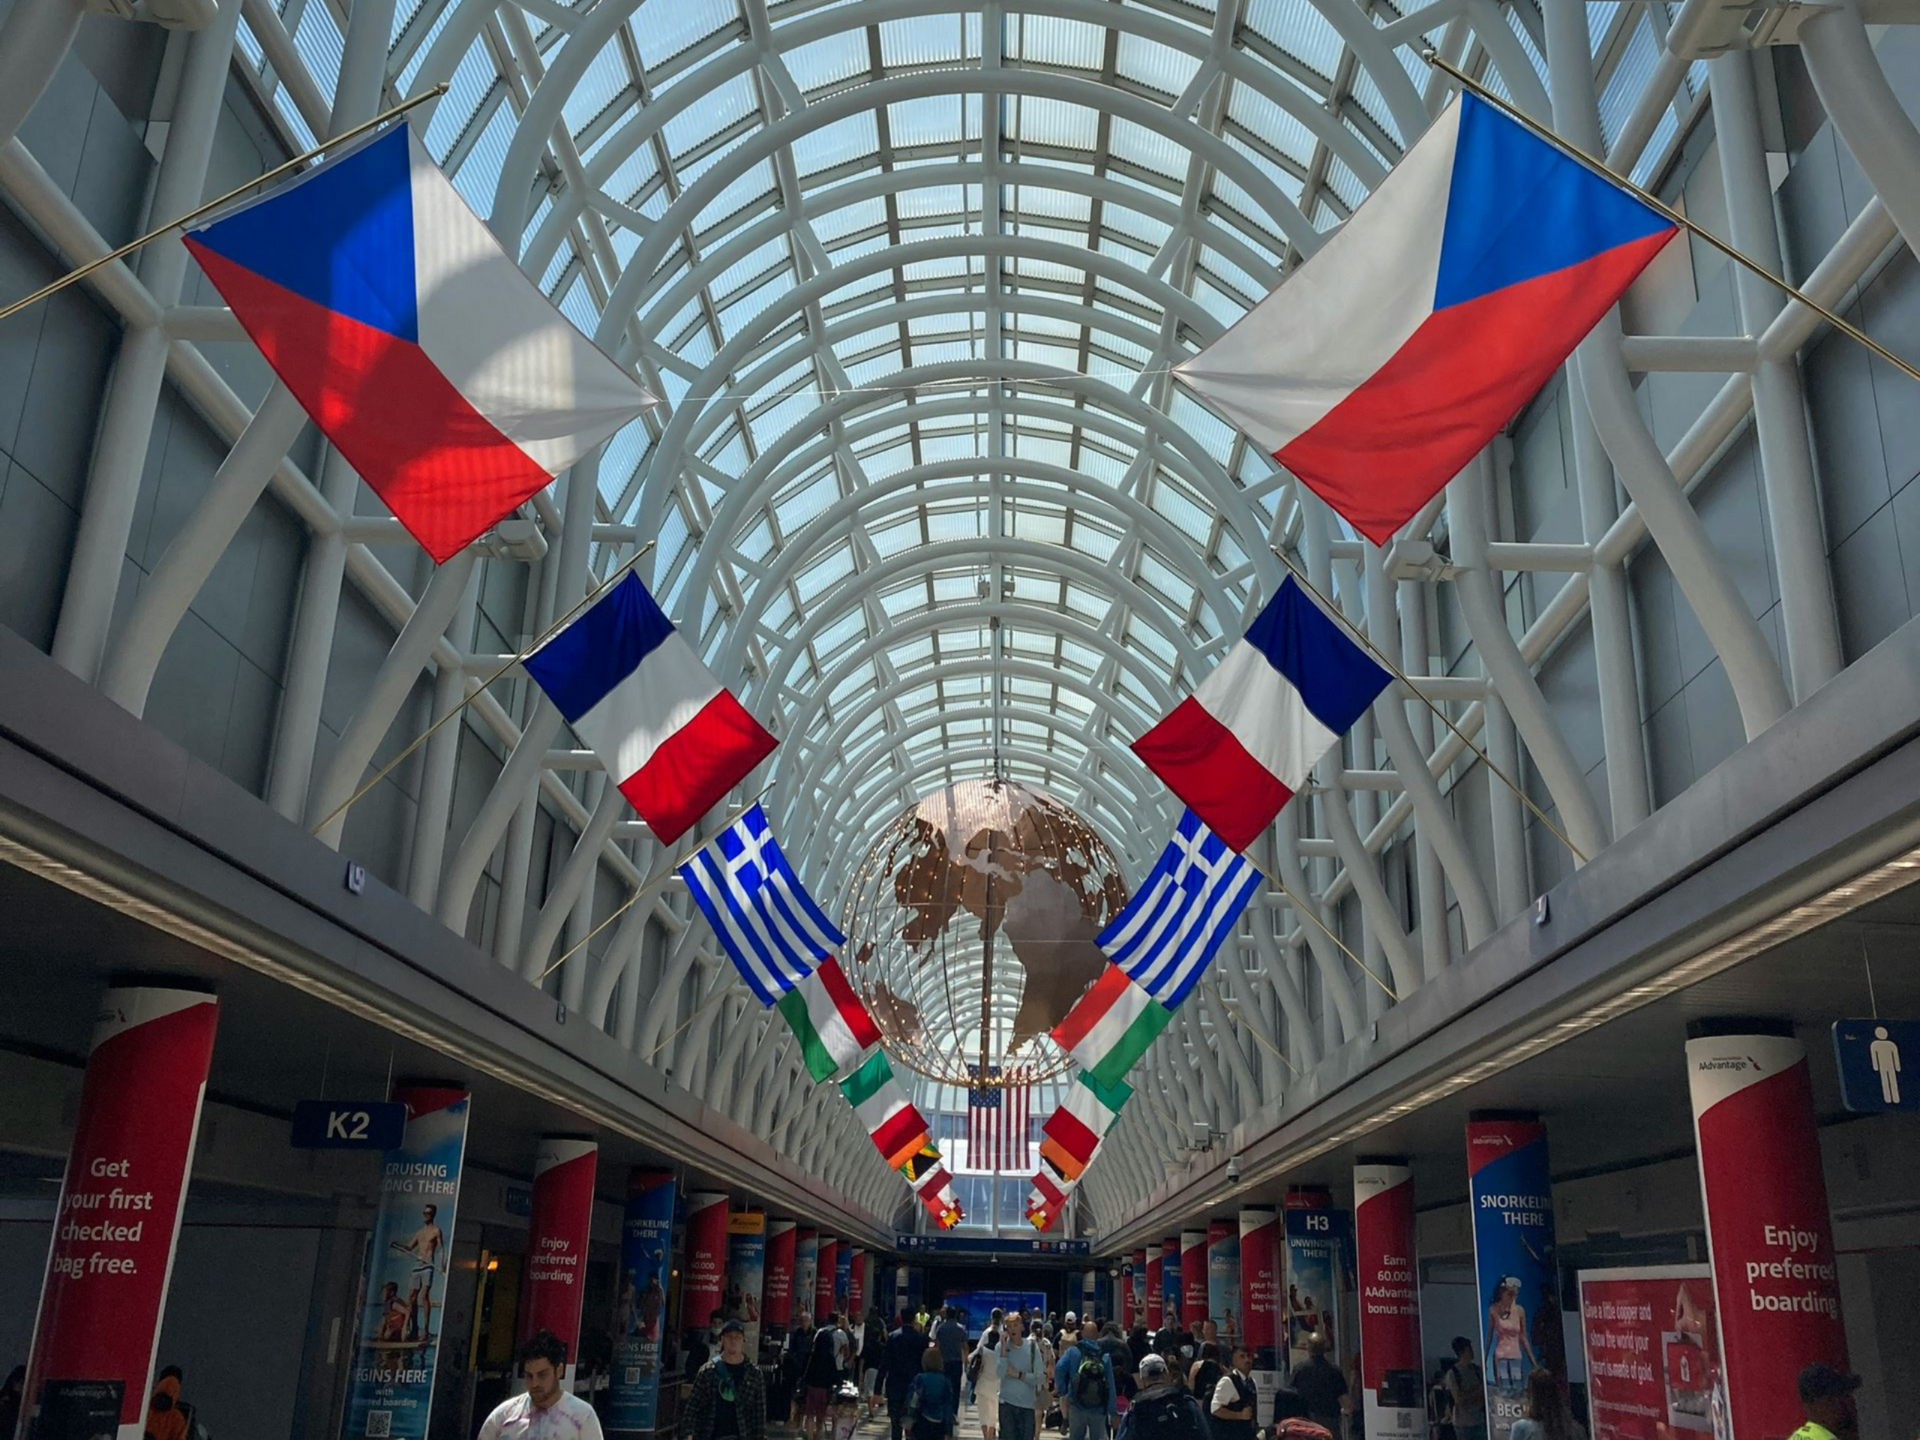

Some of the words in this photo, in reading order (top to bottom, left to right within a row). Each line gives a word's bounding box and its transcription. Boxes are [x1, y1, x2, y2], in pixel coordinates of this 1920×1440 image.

[326, 1110, 370, 1140] K2
[90, 1157, 130, 1178] Get
[386, 1162, 447, 1178] CRUISING
[417, 1180, 456, 1195] THERE
[63, 1191, 104, 1216] your
[108, 1188, 153, 1211] first
[1306, 1215, 1330, 1231] H3
[1502, 1211, 1545, 1226] THERE
[61, 1220, 142, 1243] checked
[632, 1229, 659, 1239] THERE
[1764, 1224, 1818, 1254] Enjoy
[541, 1236, 570, 1251] Enjoy
[54, 1252, 86, 1280] bag
[89, 1251, 138, 1275] free.
[531, 1253, 578, 1267] preferred
[1383, 1254, 1407, 1266] Earn
[1746, 1256, 1836, 1284] preferred
[1367, 1302, 1398, 1315] bonus
[1750, 1288, 1838, 1320] boarding
[395, 1367, 429, 1384] HERE
